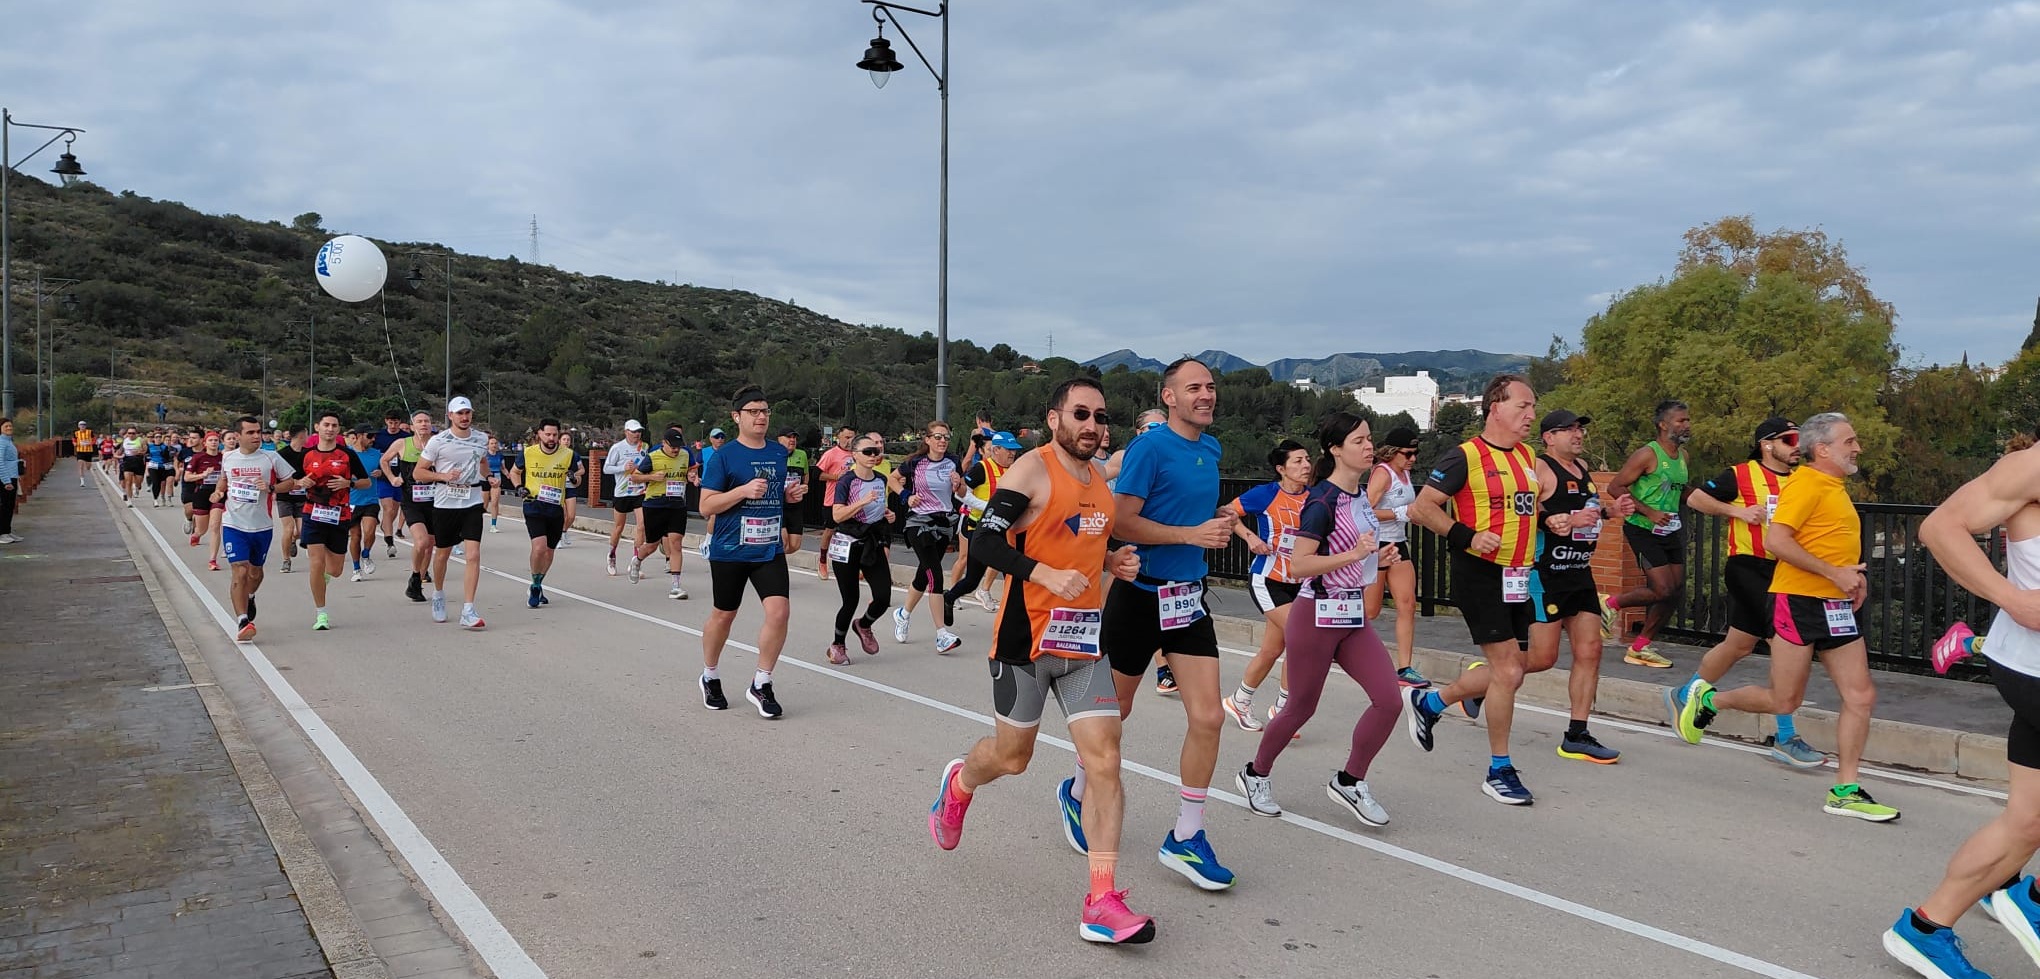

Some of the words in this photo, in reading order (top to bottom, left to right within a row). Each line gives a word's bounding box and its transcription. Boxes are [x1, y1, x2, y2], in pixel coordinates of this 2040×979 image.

[1175, 597, 1195, 610] 890
[1337, 603, 1349, 611] 41
[1058, 625, 1087, 635] 1264
